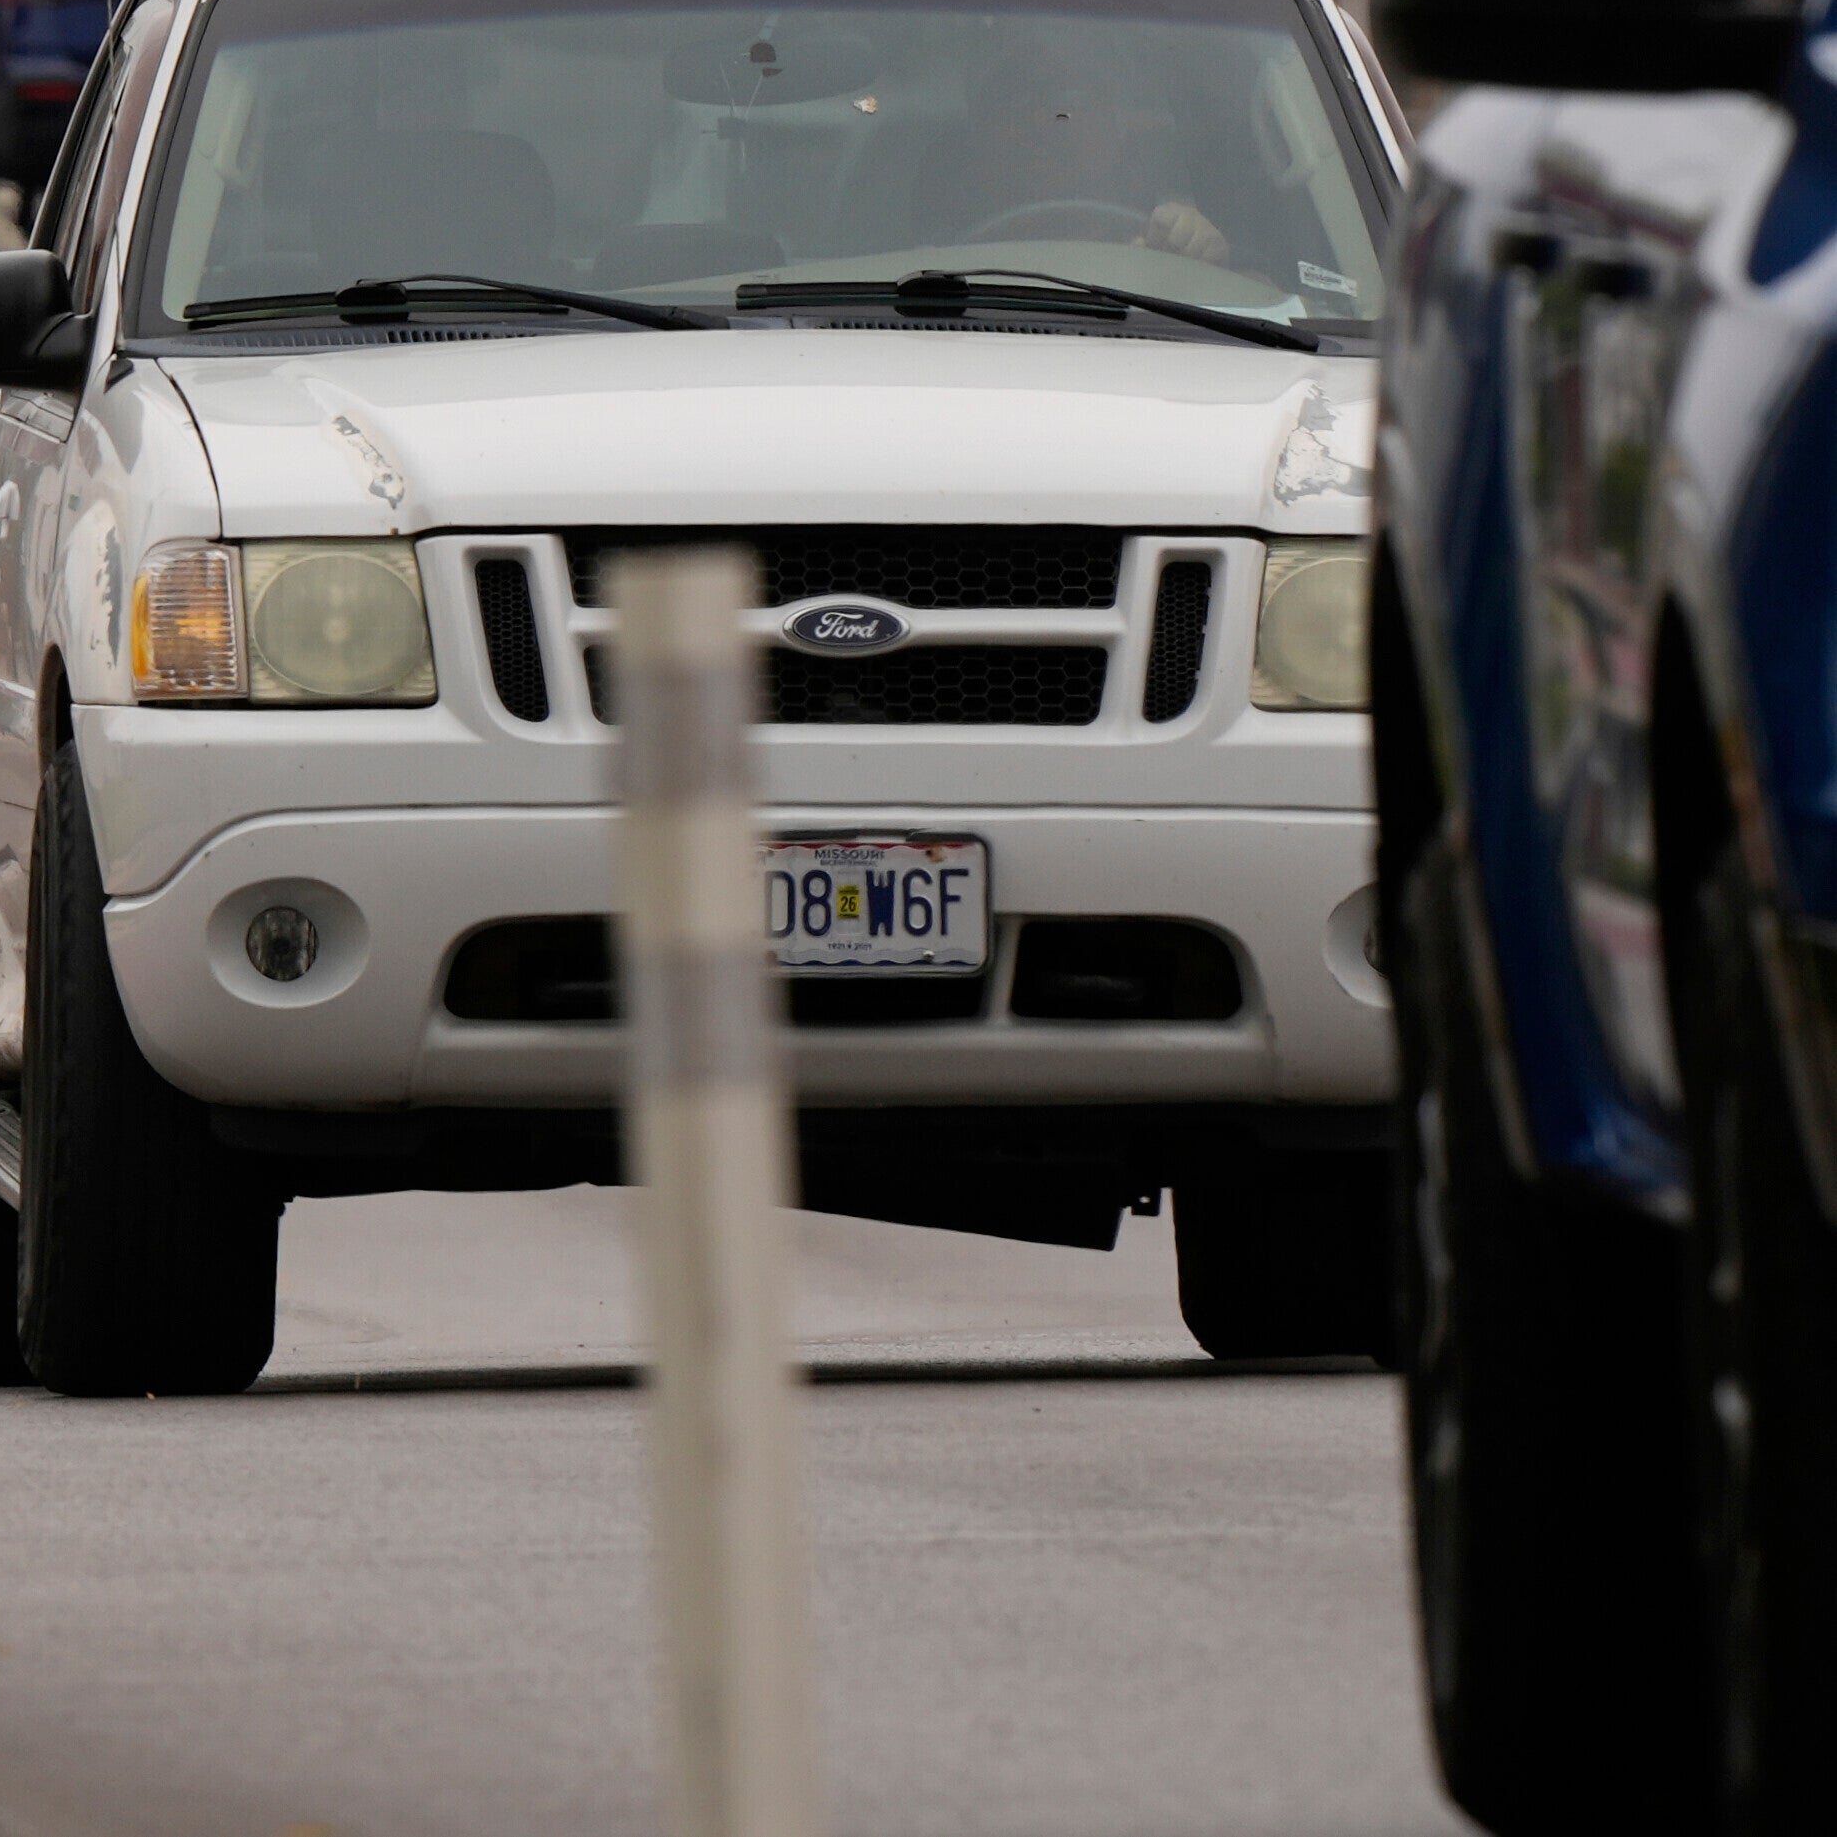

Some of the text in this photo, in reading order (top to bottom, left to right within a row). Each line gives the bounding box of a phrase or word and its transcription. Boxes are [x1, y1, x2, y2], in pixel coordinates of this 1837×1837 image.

[814, 610, 878, 643] Ford
[840, 895, 857, 913] 26
[866, 867, 970, 937] W6F
